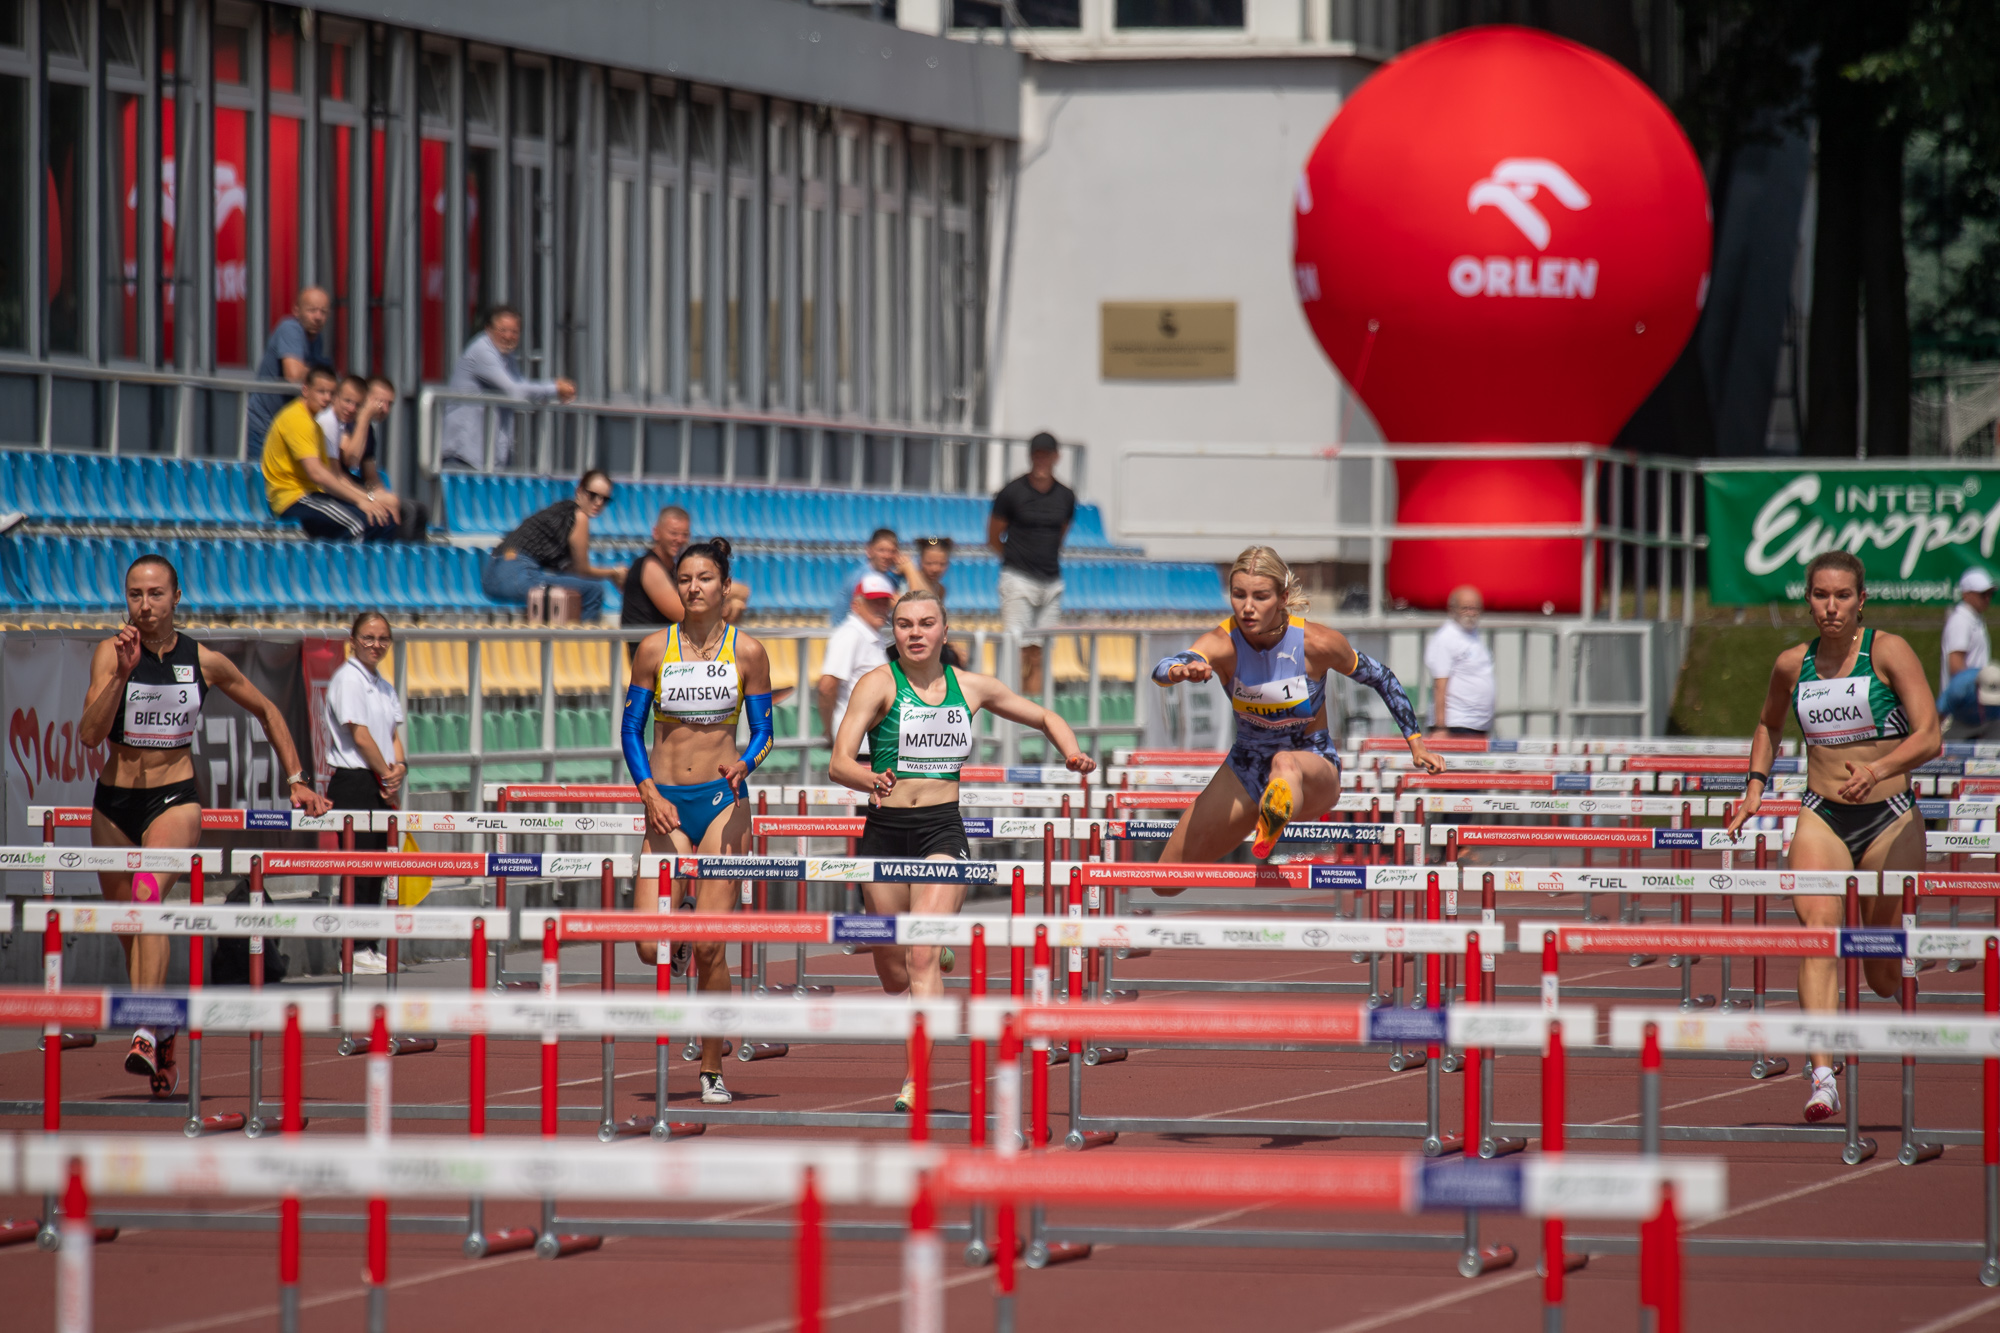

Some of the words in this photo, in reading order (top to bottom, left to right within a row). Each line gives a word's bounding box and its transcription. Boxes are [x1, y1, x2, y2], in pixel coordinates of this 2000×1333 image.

[1449, 256, 1599, 299] ORLEN
[663, 665, 694, 678] Europol
[707, 664, 727, 678] 86
[129, 690, 162, 703] Europol
[668, 687, 731, 701] ZAITSEVA
[1282, 685, 1293, 700] 1
[1802, 688, 1830, 701] Europol
[1846, 683, 1855, 697] 4
[179, 690, 188, 704] 3
[134, 712, 189, 726] BIELSKA
[903, 709, 937, 722] Europol
[947, 710, 962, 724] 85
[1809, 705, 1863, 724] SŁOCKA
[130, 739, 173, 747] WARSZAWA
[906, 733, 968, 747] MATUZNA
[1813, 735, 1852, 745] WARSZAWA
[1853, 732, 1871, 741] 2023
[1492, 802, 1519, 810] FUEL
[1530, 800, 1568, 809] TOTALbet
[477, 820, 508, 829] FUEL
[520, 817, 564, 828] TOTALbet
[600, 820, 622, 828] Okęcie
[779, 823, 825, 831] MISTRZOSTWA
[1000, 820, 1036, 834] Europol
[1283, 827, 1349, 838] WARSZAWA
[1710, 832, 1746, 845] Eurool
[1945, 836, 1990, 845] TOTALbet
[88, 856, 114, 865] Okęcie
[292, 860, 346, 868] MISTRZOSTWA
[550, 857, 592, 874] Europol
[820, 860, 857, 871] Europol
[881, 864, 958, 878] WARSZAWA
[1205, 871, 1259, 879] WIELOBOJACH
[1260, 871, 1278, 879] U20,
[1375, 869, 1417, 885] Europol
[1590, 878, 1627, 889] FUEL
[1642, 874, 1695, 886] TOTALbet
[1739, 878, 1766, 887] Okęcie
[1925, 880, 1947, 888] PLA
[174, 917, 218, 930] FUEL
[235, 914, 297, 928] TOTALbet
[1160, 931, 1205, 945] FUEL
[1222, 928, 1285, 943] TOTALbet
